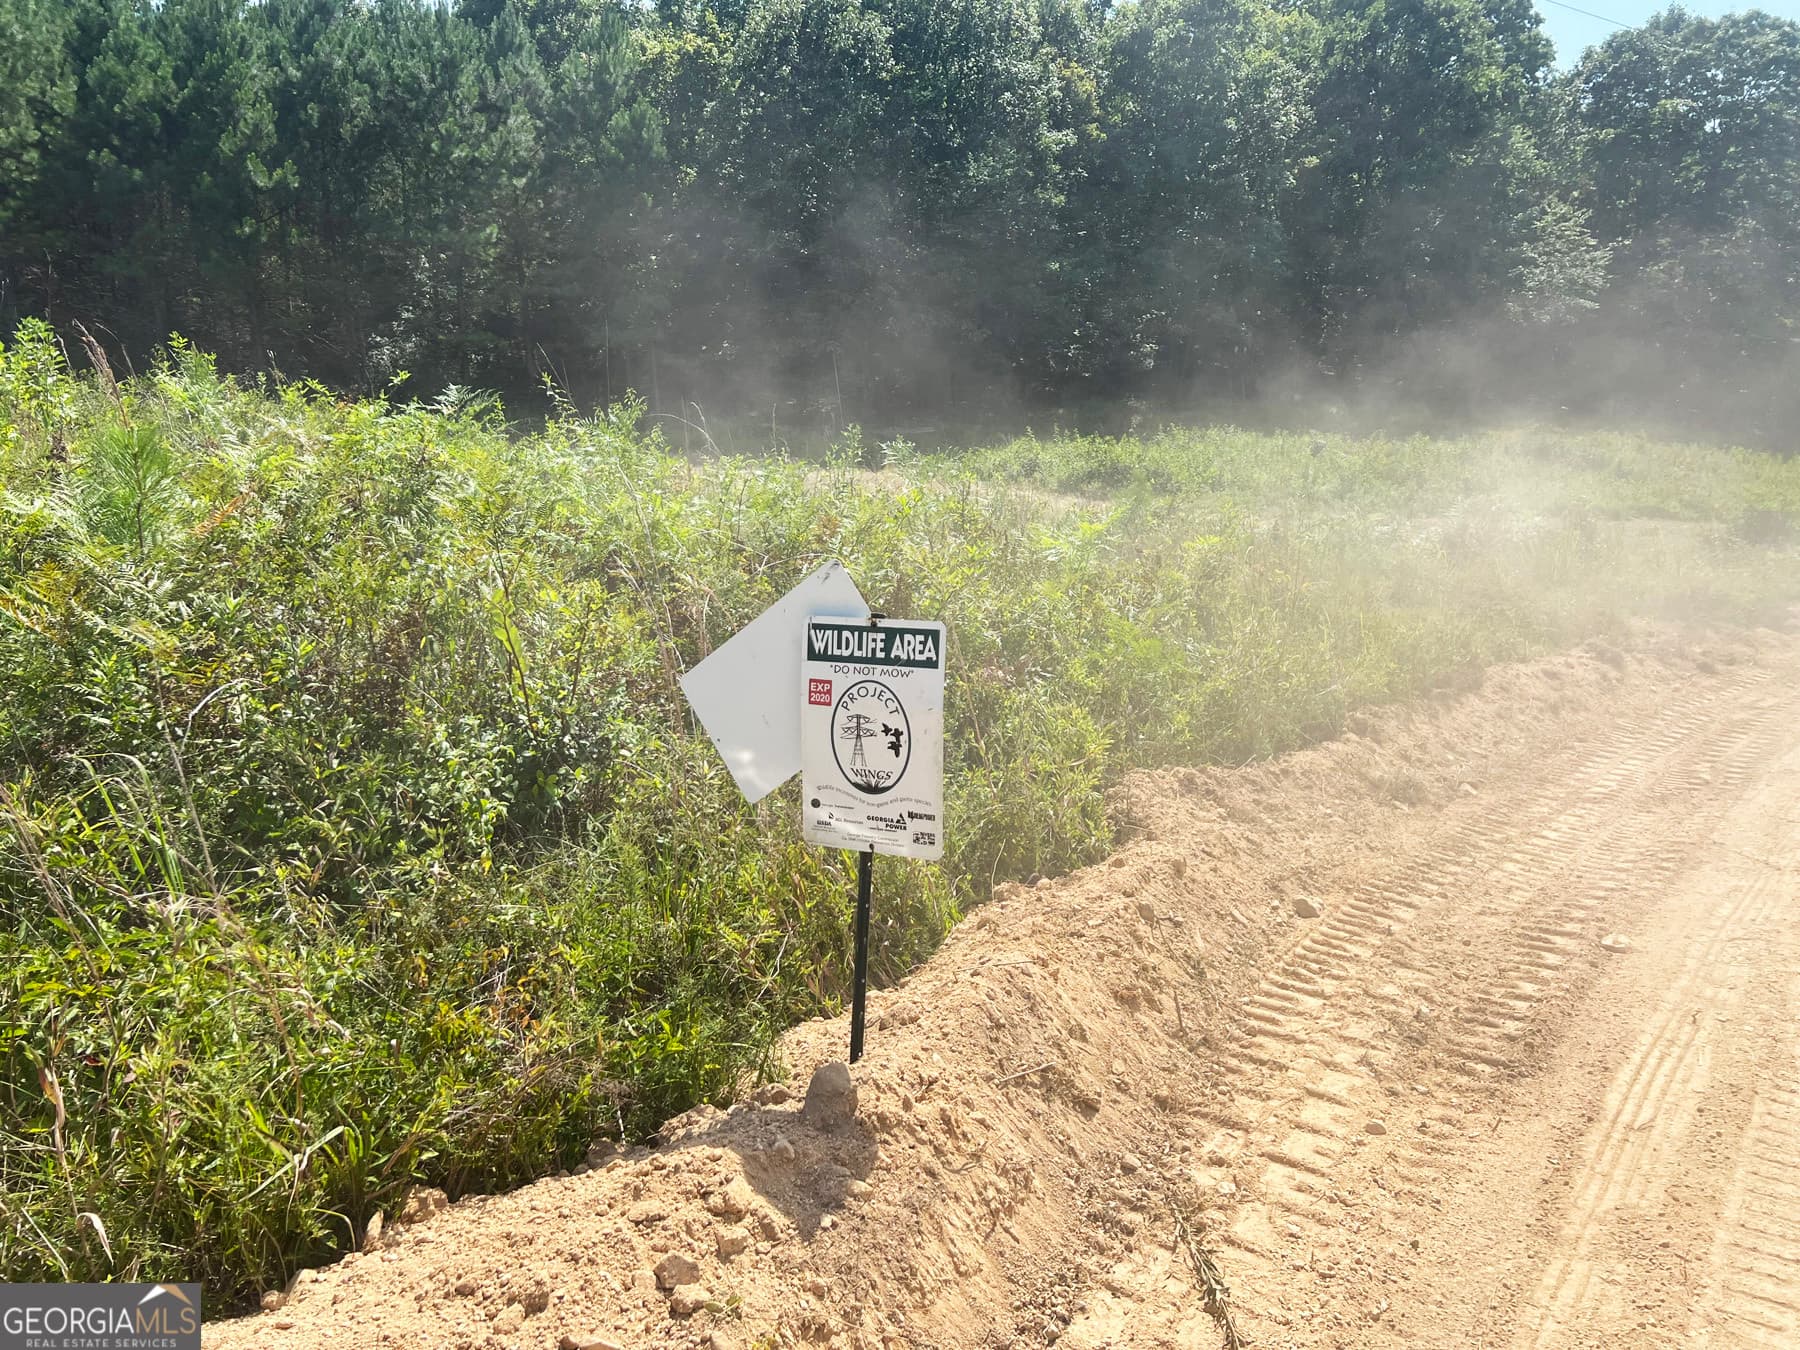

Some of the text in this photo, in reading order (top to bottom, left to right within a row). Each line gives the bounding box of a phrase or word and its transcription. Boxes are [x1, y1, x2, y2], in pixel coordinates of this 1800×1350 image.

[810, 629, 937, 661] WILDLIFE AREA
[853, 666, 877, 676] NOT
[810, 682, 831, 692] EXP
[810, 693, 831, 703] 2020
[841, 686, 900, 716] PROJECT
[850, 767, 893, 780] WINGS
[866, 815, 895, 824] GEORGIA
[885, 823, 907, 831] POWER
